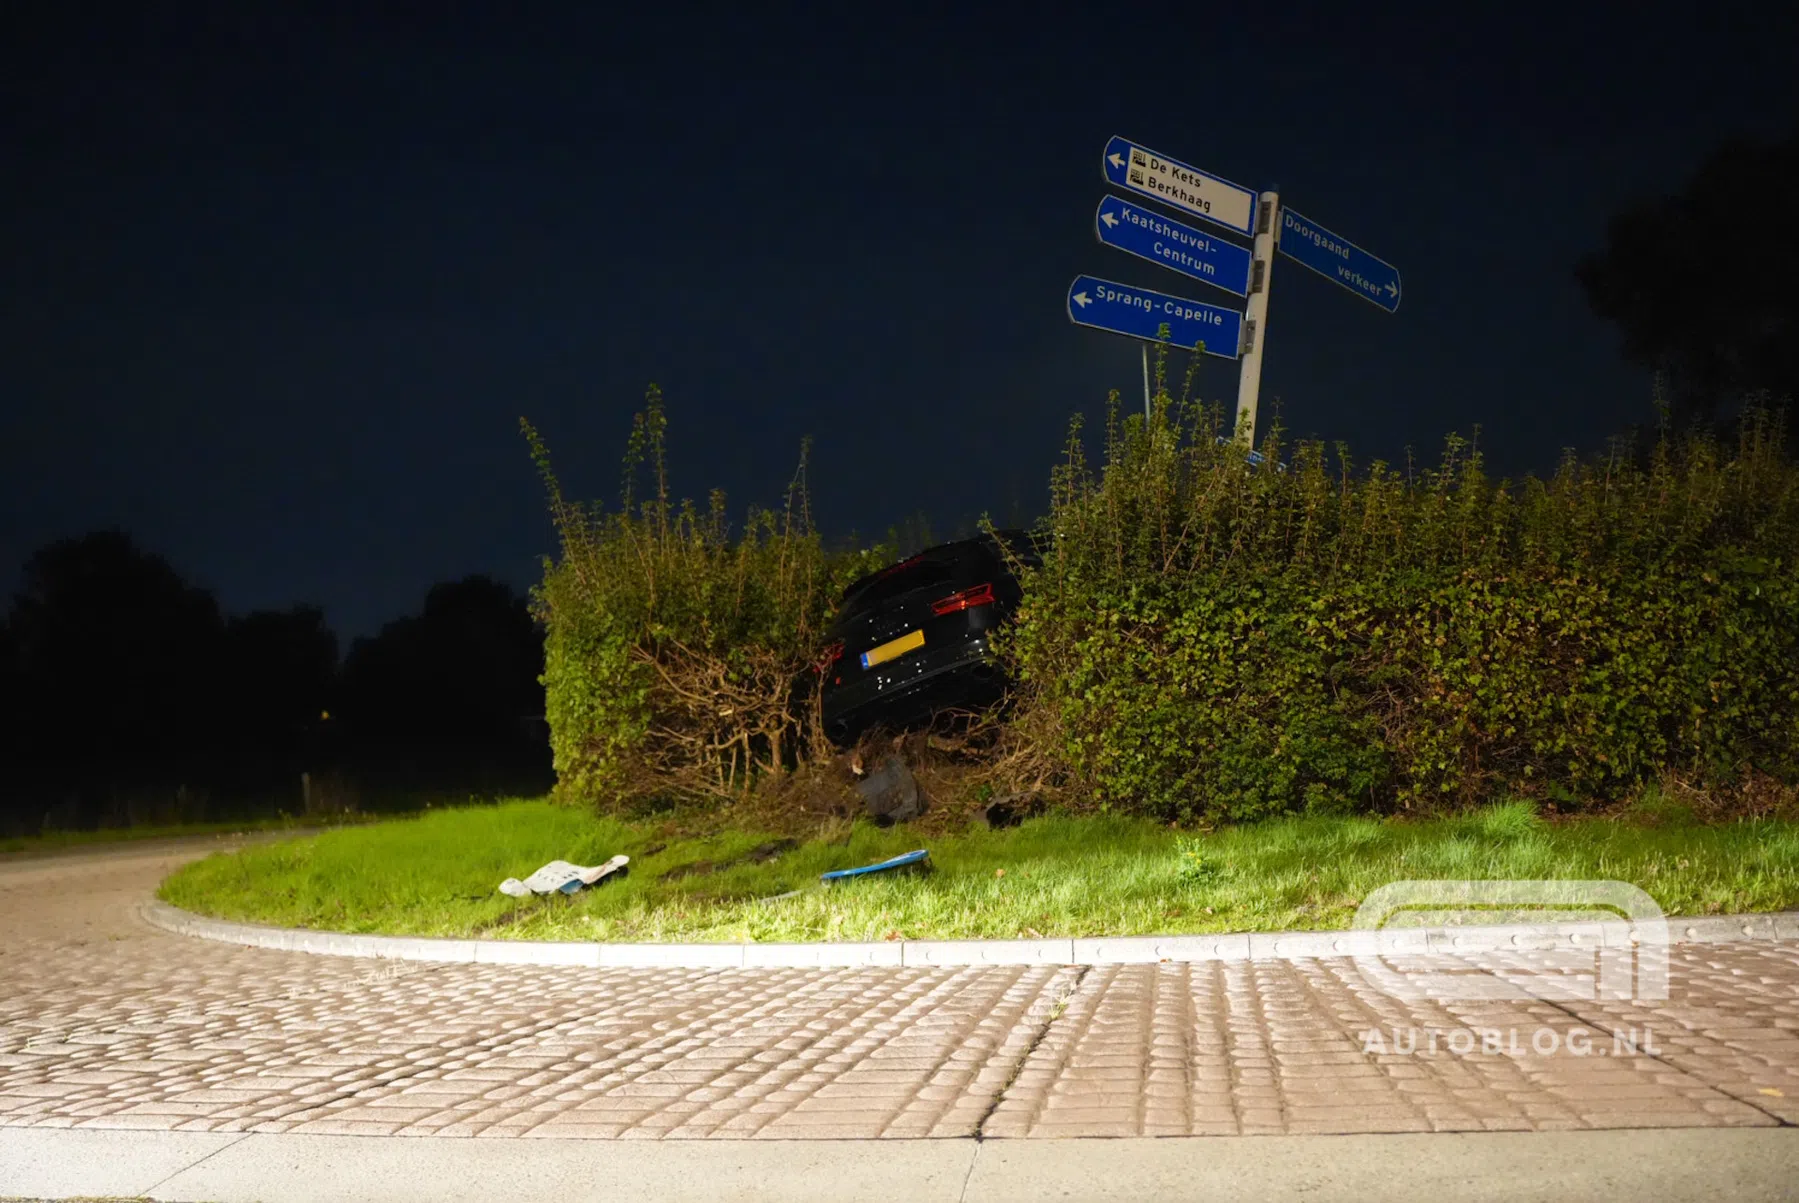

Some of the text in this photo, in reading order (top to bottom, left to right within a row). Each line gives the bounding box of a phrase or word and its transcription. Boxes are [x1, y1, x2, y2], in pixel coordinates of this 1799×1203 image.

[1150, 158, 1202, 188] De Kets
[1148, 176, 1211, 213] Berkhaag
[1121, 208, 1217, 253] Kaatsheuvel-
[1285, 214, 1350, 260] Doorgaand
[1153, 241, 1215, 276] Centrum
[1336, 265, 1382, 297] verkeer
[1096, 285, 1223, 326] Sprang-Capelle
